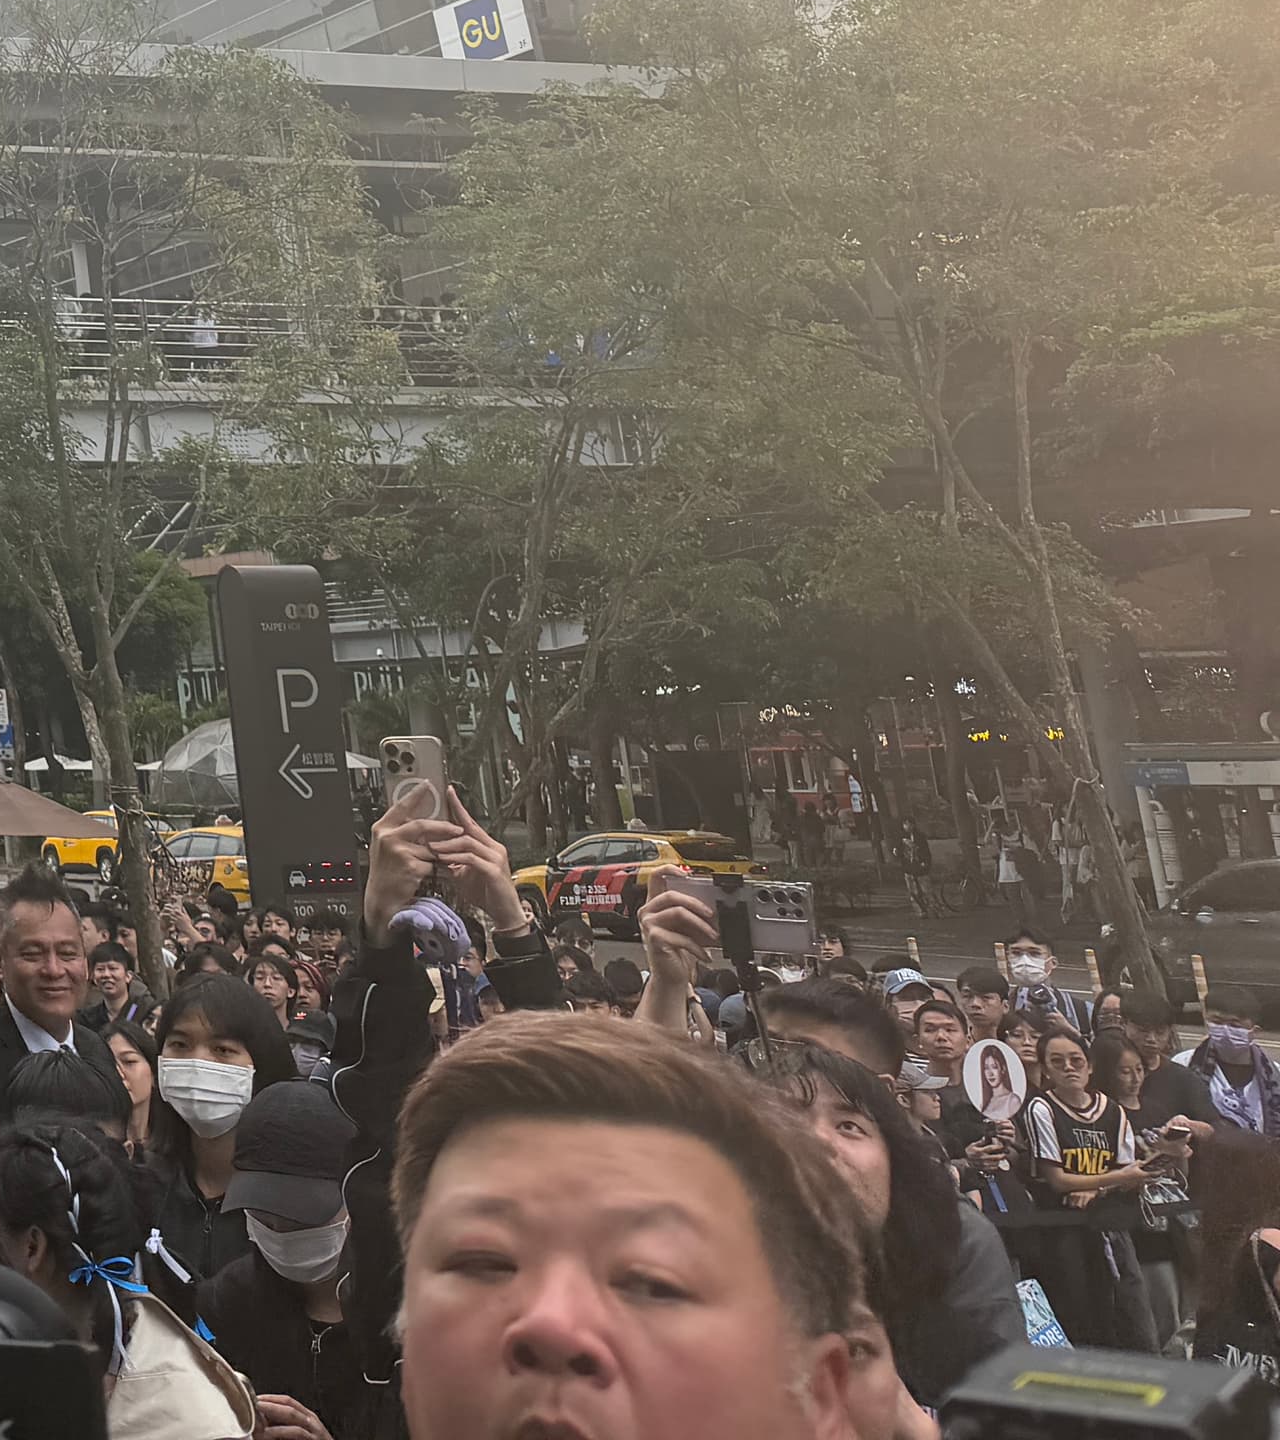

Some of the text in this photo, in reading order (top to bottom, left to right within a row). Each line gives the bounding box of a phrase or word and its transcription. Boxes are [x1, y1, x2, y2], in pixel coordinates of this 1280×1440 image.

[462, 11, 501, 49] GU
[276, 668, 319, 733] P
[1063, 1147, 1115, 1175] TWIC
